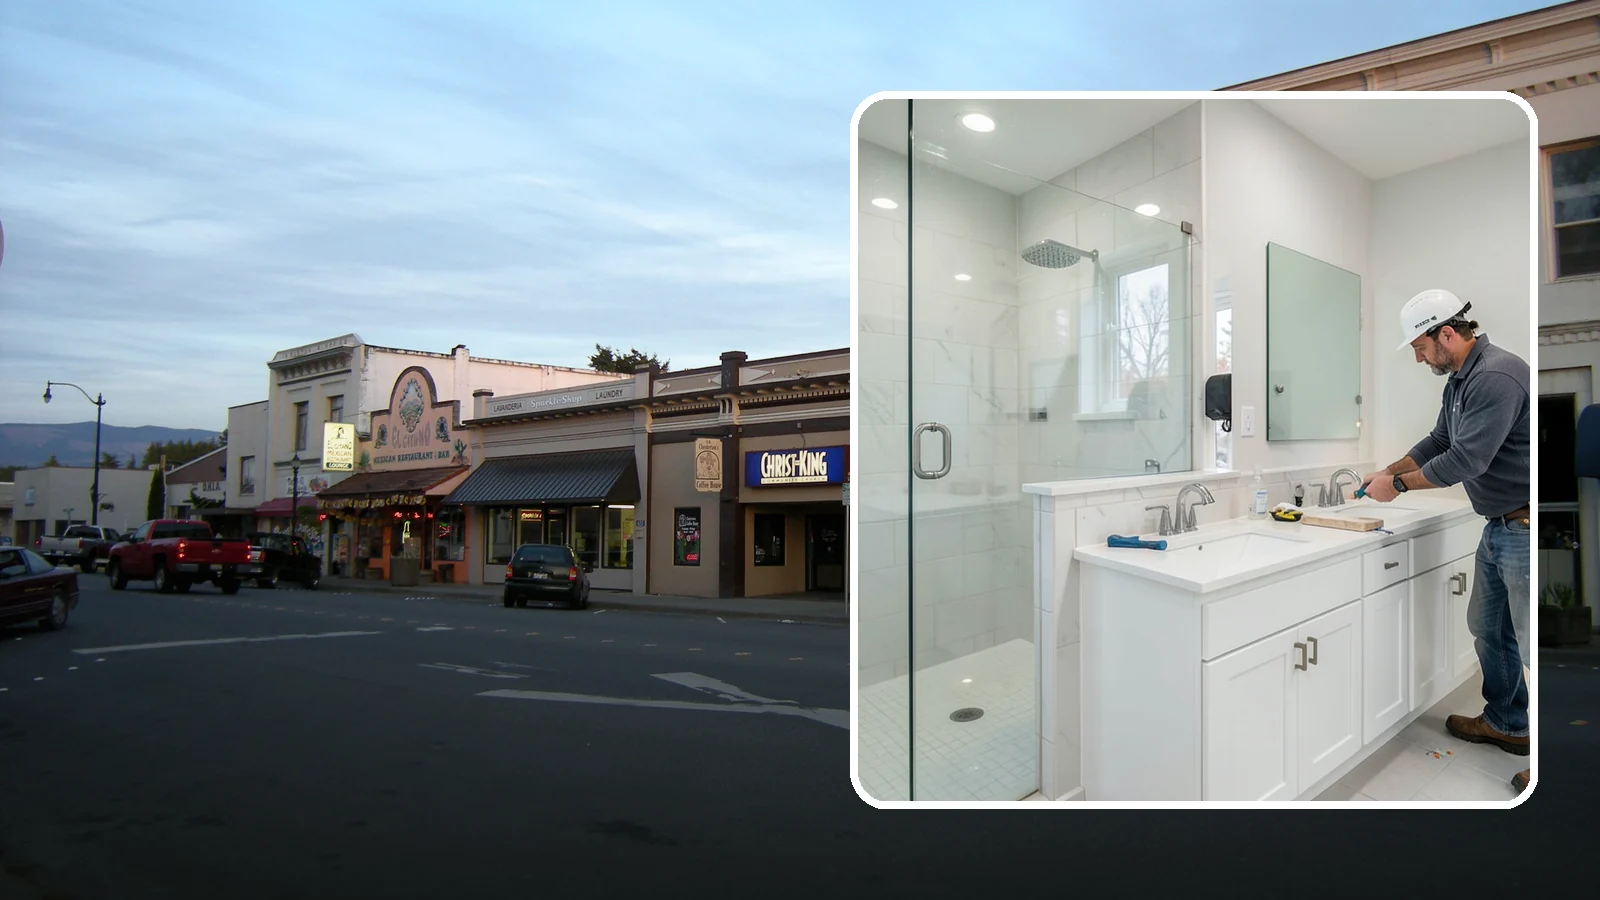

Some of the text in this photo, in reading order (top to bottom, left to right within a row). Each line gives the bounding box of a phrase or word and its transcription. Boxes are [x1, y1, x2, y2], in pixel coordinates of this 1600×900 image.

[531, 394, 582, 409] Sparkle Shop
[595, 389, 623, 400] LAUNDRY
[494, 402, 522, 412] LAVANDERIA
[392, 425, 401, 449] EL
[373, 455, 396, 464] MEXICAN
[397, 452, 433, 462] RESTAURANT
[438, 450, 450, 459] BAR
[760, 449, 828, 478] CHRIST KING
[696, 481, 722, 489] Coffee House
